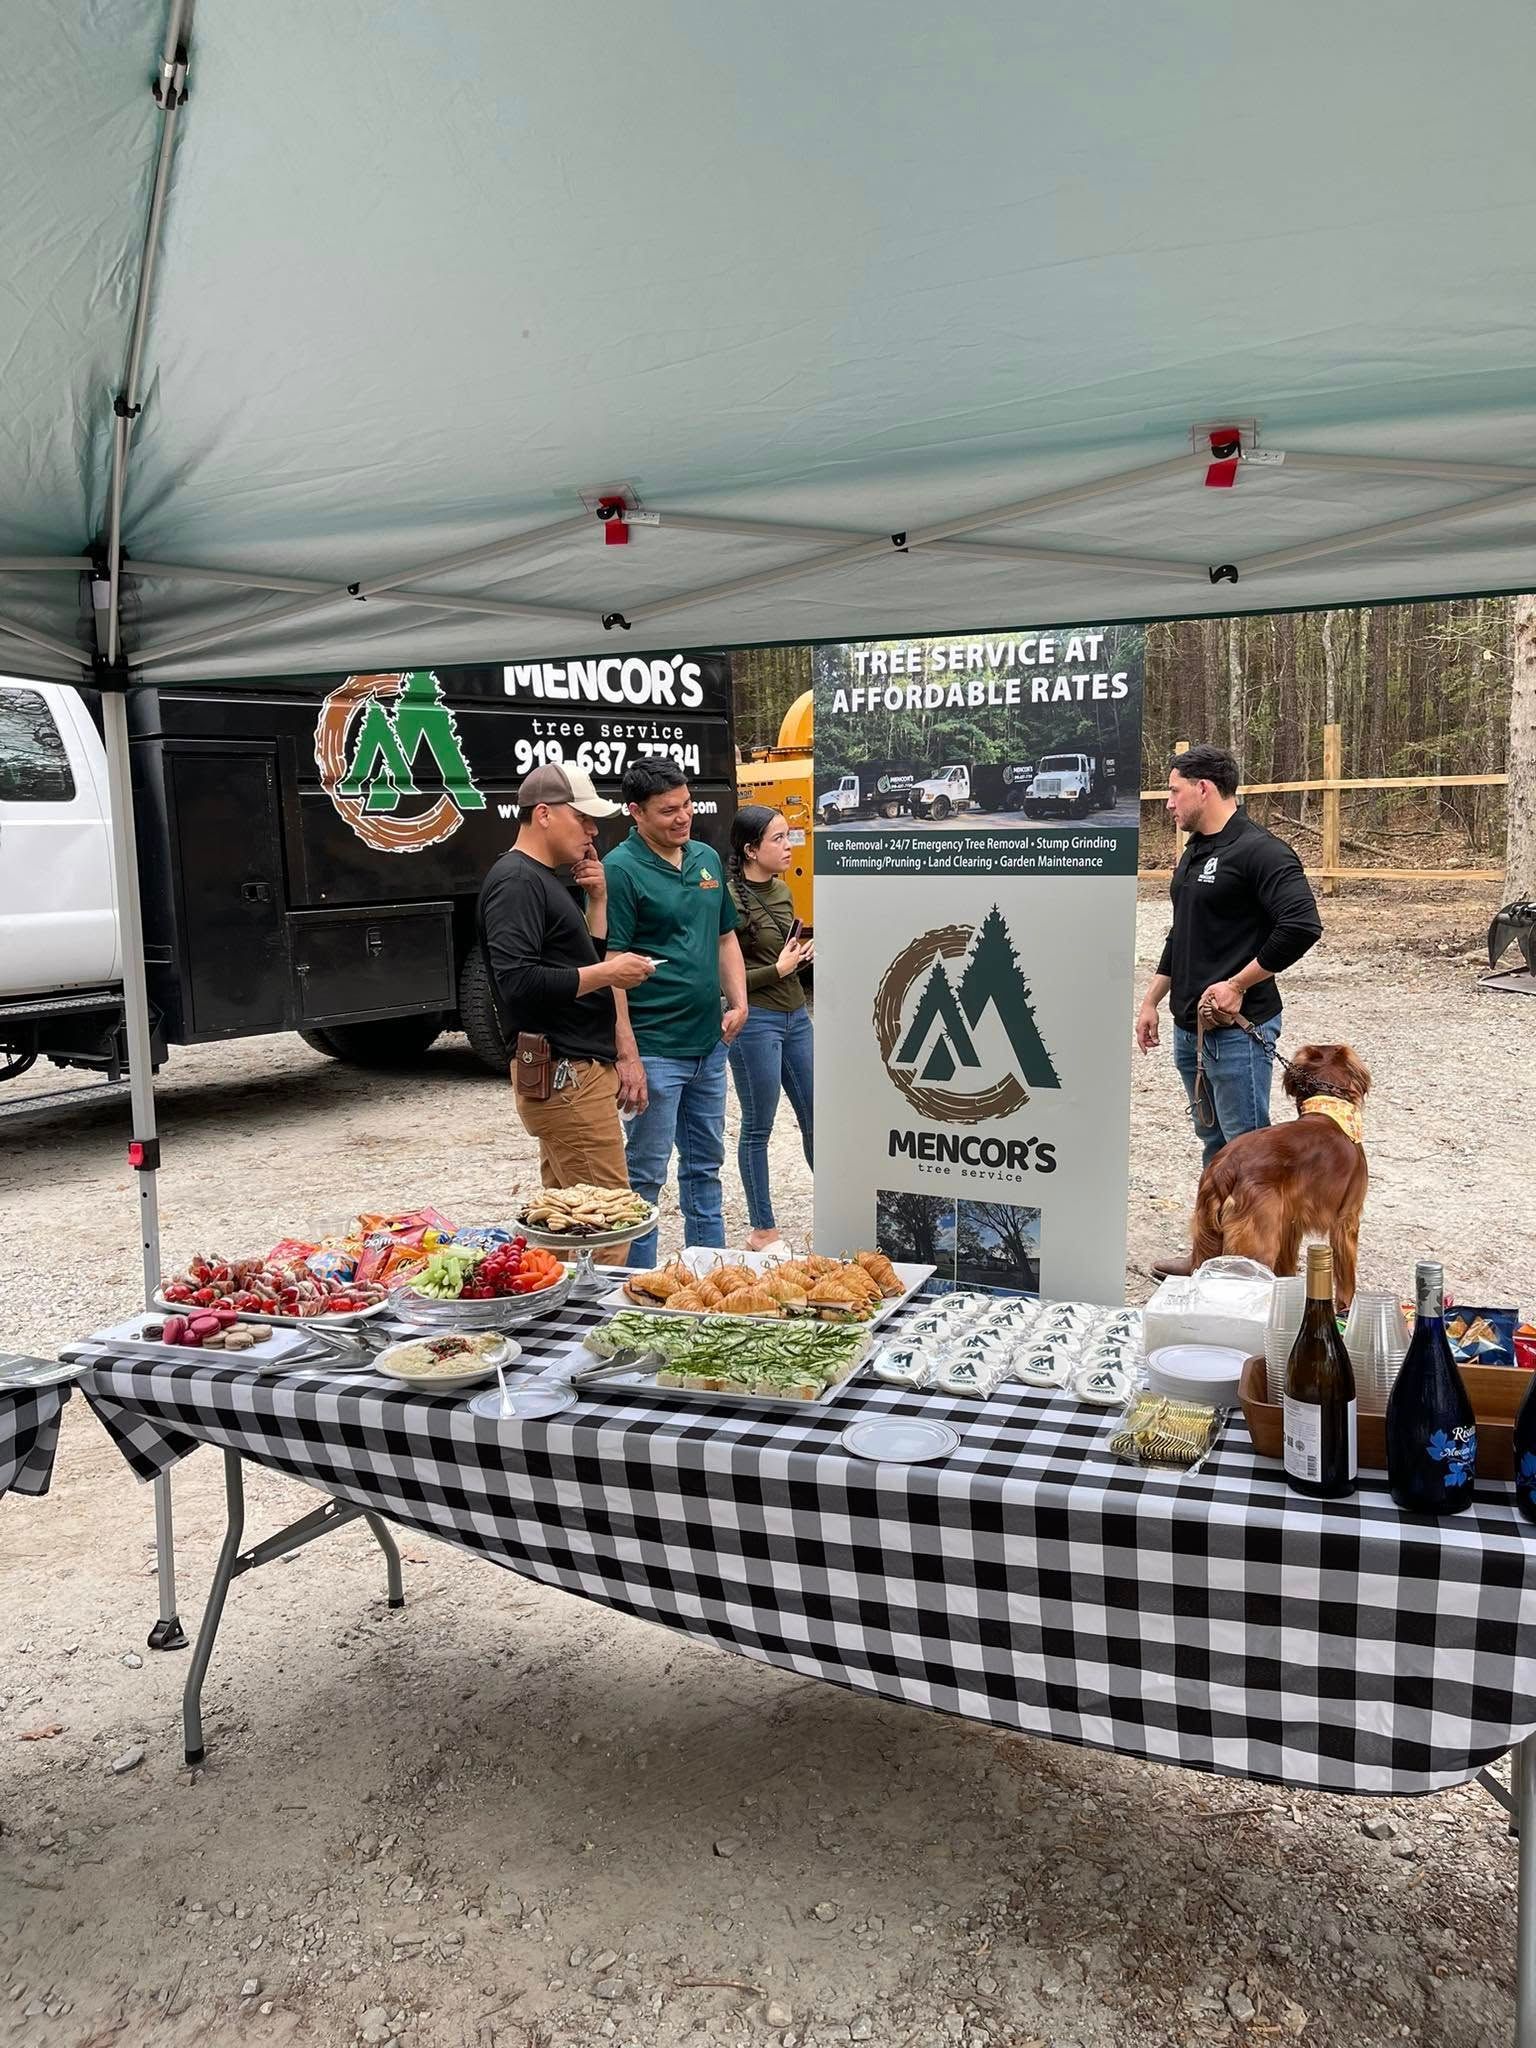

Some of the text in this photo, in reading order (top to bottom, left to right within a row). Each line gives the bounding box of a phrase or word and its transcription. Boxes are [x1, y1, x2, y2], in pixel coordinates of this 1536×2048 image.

[855, 634, 1105, 676] TREE SERVICE AT
[832, 672, 1129, 714] AFFORDABLE RATES
[532, 718, 685, 740] tree service
[826, 836, 1117, 853] Tree Removal 24/7 Emergency Tree Removal Stump Grinding
[840, 855, 1103, 870] Trimming/Pruning Land Clearing Garden Maintenance
[888, 1129, 1058, 1174] MENCOR'S
[917, 1163, 1023, 1184] tree service
